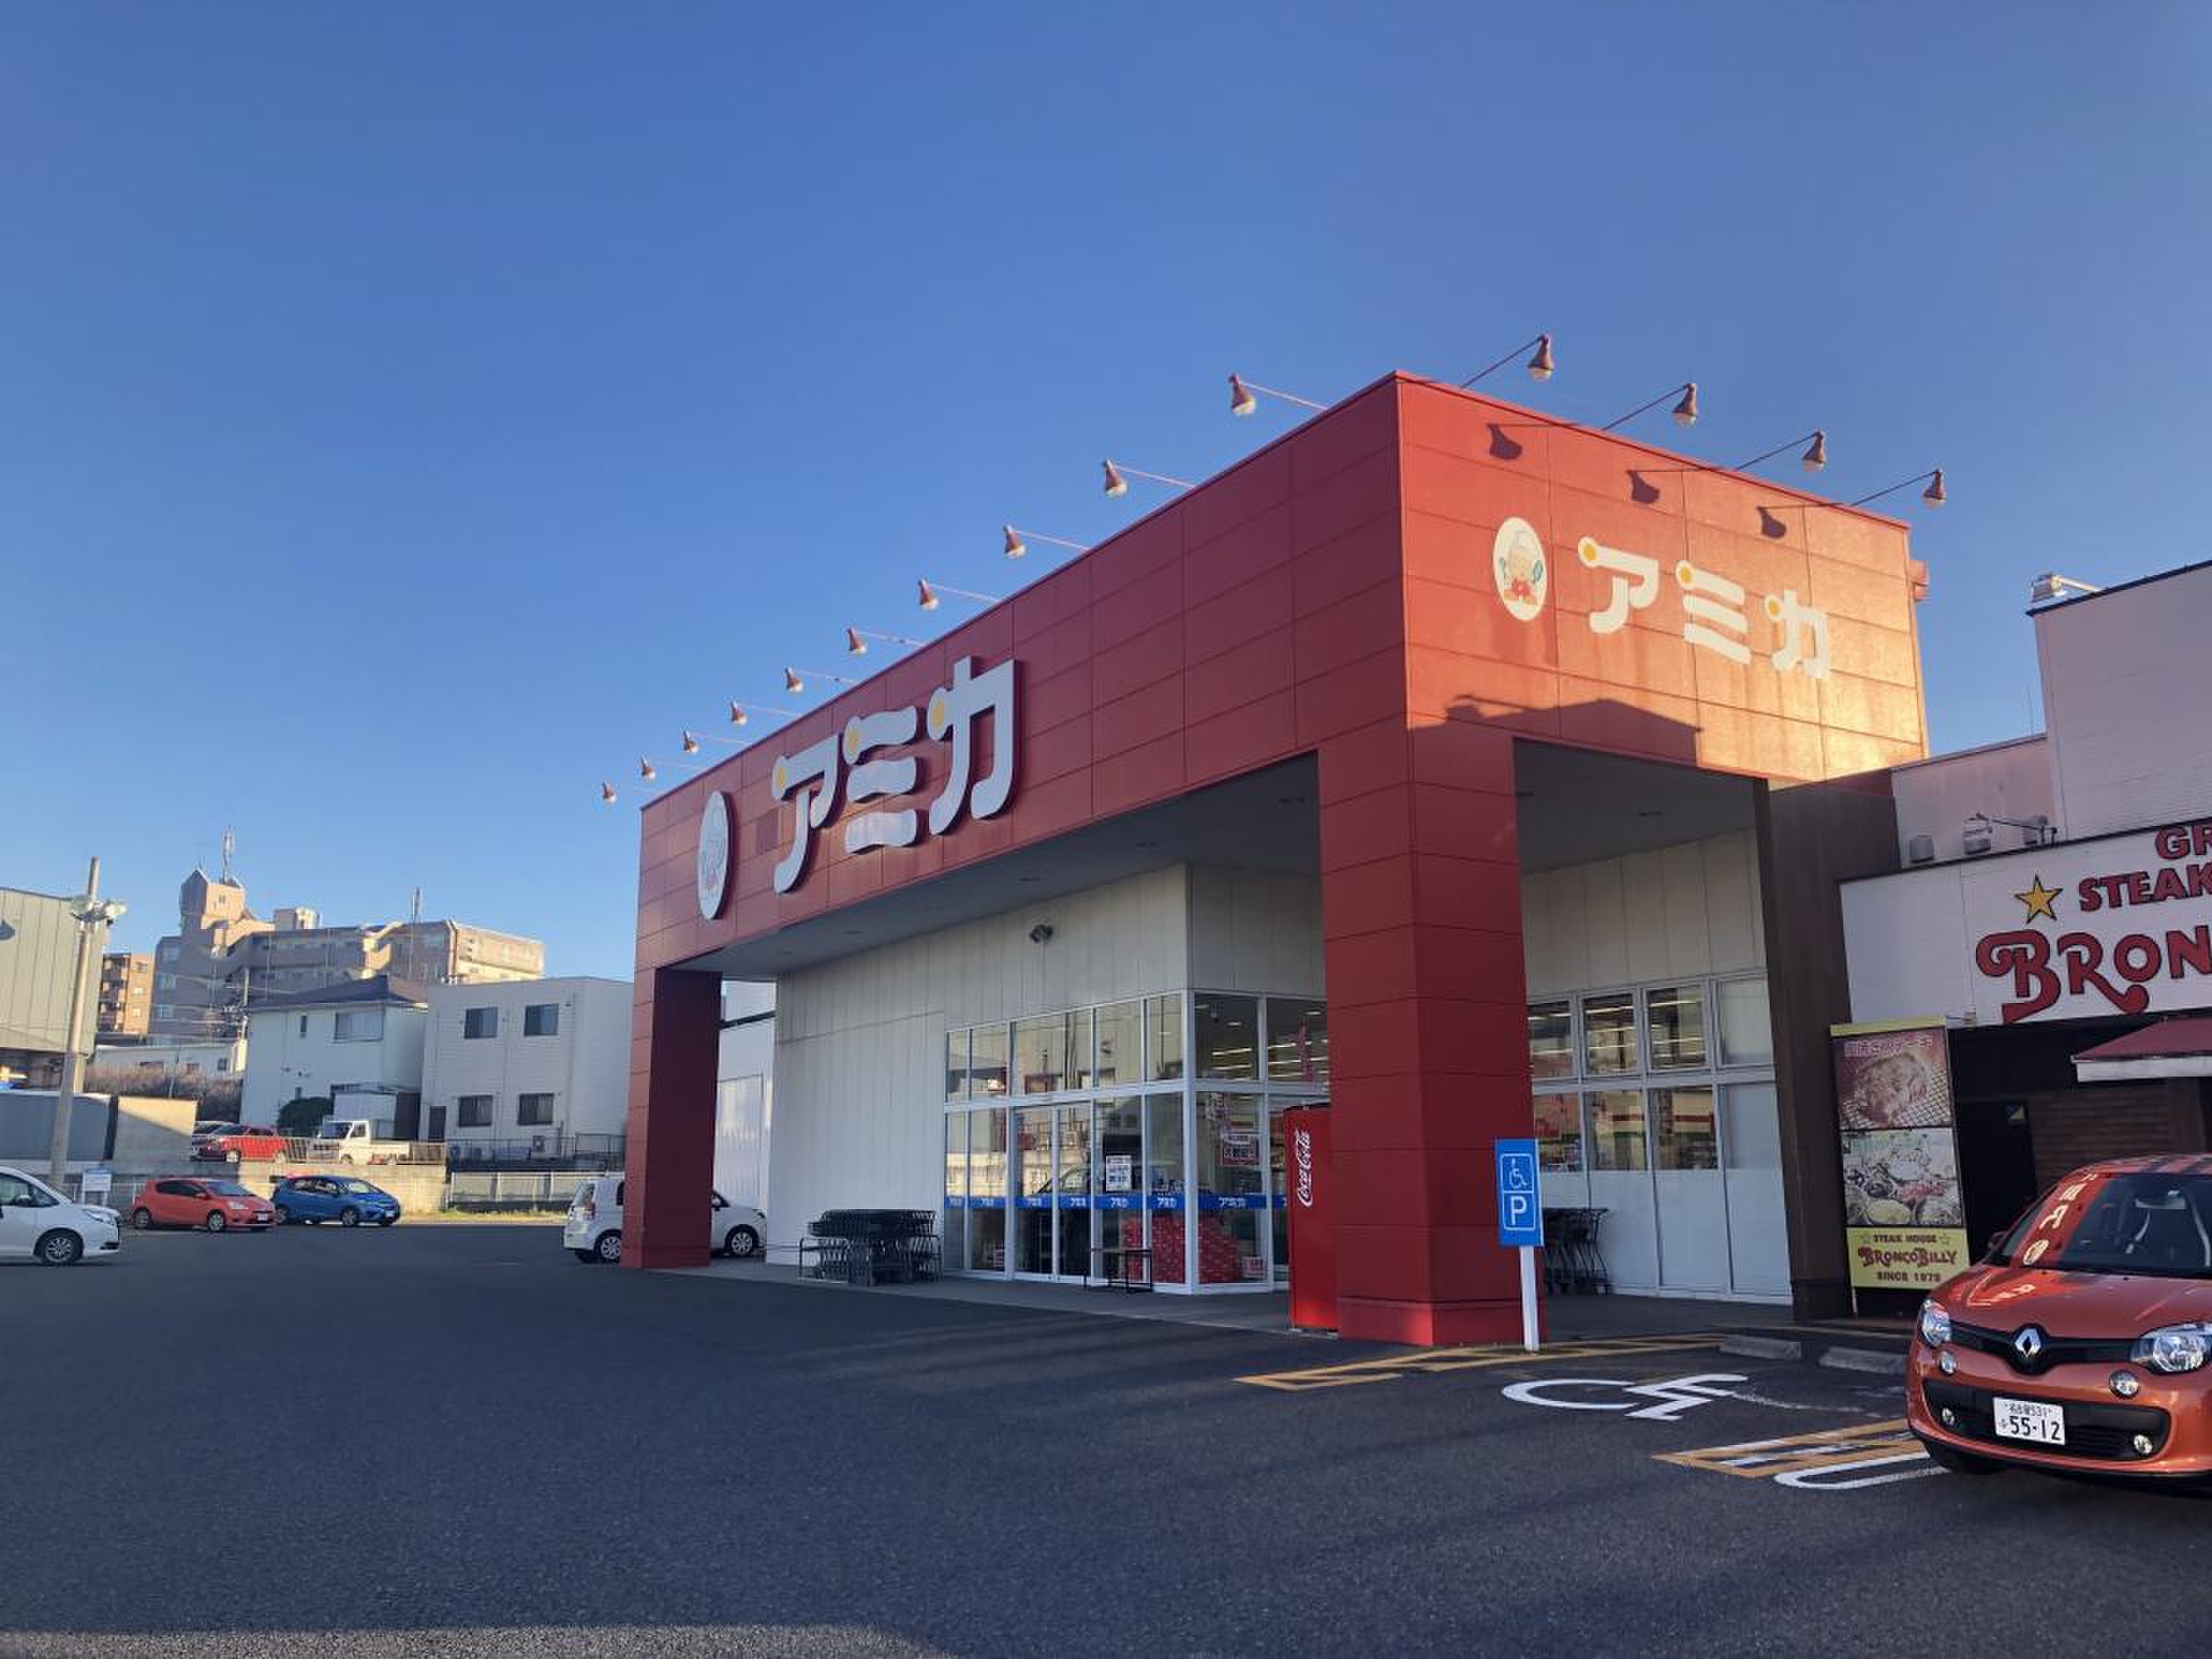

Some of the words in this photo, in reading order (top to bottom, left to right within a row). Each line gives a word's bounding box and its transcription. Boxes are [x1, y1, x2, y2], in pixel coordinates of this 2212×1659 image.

[1577, 535, 1830, 678] アミカ
[772, 656, 1017, 894] アミカ
[2079, 865, 2212, 912] STEAK
[1976, 925, 2212, 1024] BRON
[1512, 1195, 1527, 1226] P
[1877, 1271, 1909, 1282] SINCE
